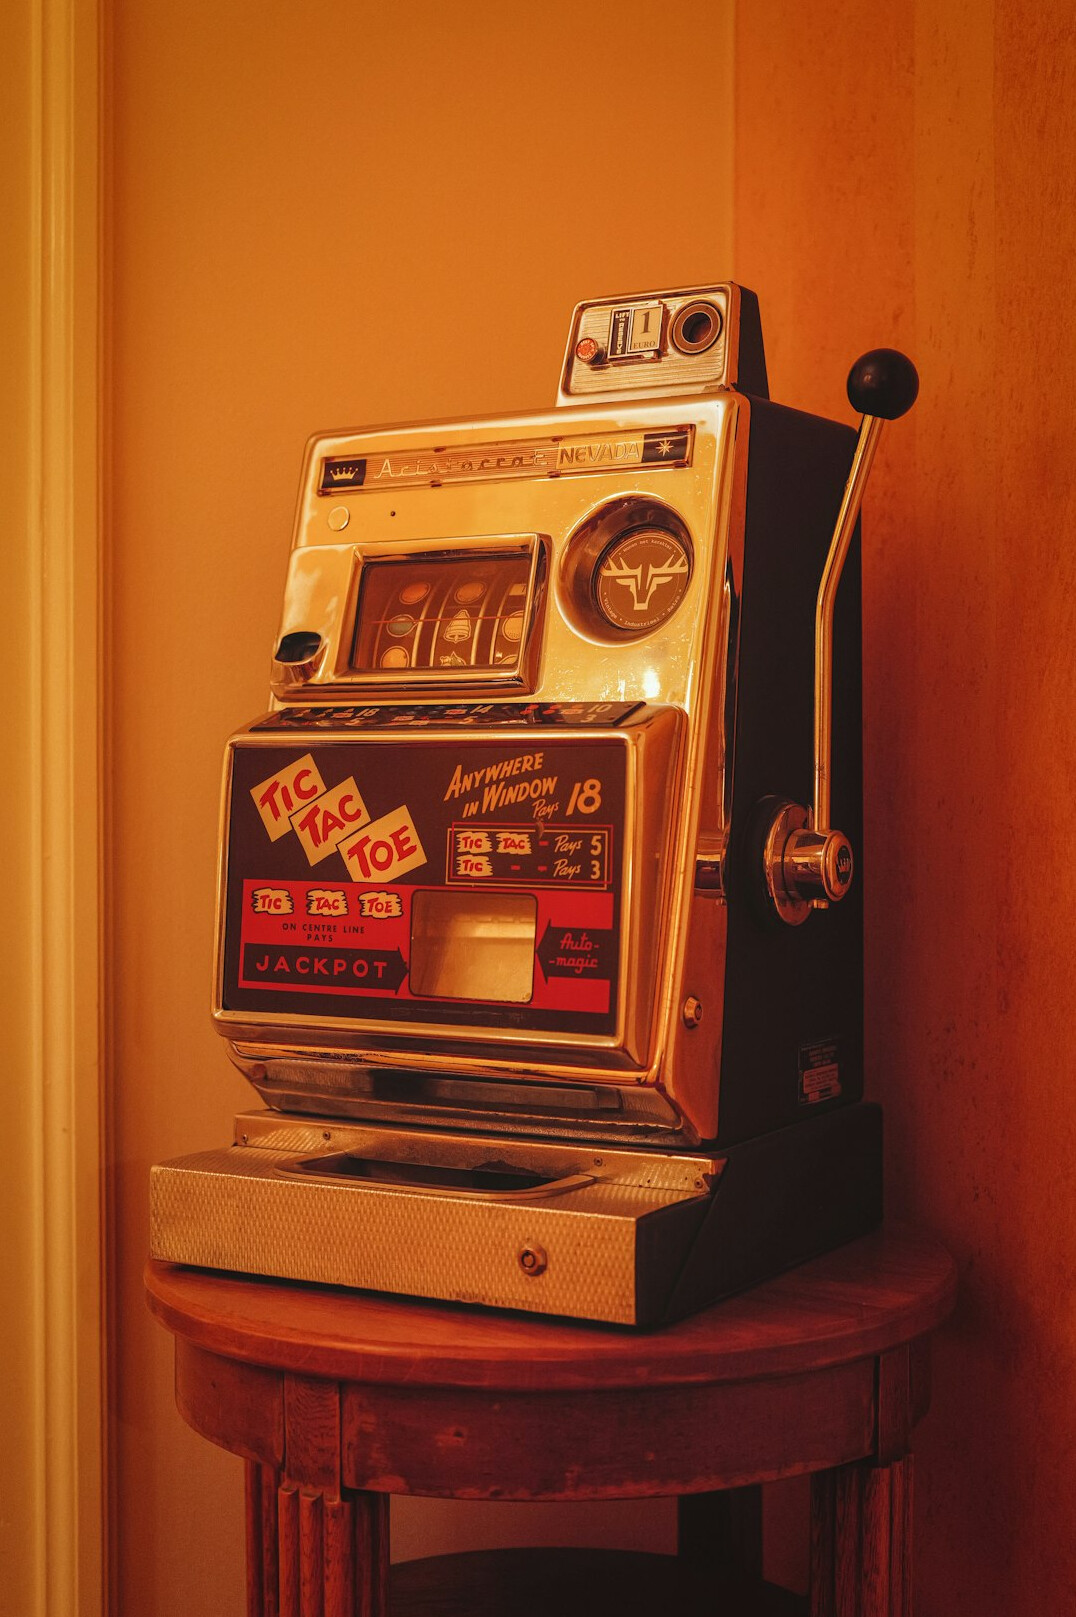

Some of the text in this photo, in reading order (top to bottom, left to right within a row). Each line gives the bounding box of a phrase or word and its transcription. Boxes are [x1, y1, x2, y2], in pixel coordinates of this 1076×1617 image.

[640, 311, 651, 334] 1
[633, 340, 656, 349] EURO
[560, 442, 640, 464] NEVADA
[580, 714, 598, 723] 3
[587, 704, 612, 713] 10
[443, 752, 544, 801] ANYWHERE
[259, 769, 318, 821] TIC
[532, 778, 602, 819] Pays 18
[462, 801, 479, 818] IN
[298, 794, 362, 848] TAC
[347, 825, 417, 879] TOE
[462, 834, 602, 856] TIC TAC Pays 5
[462, 858, 601, 879] TIC Pays 3
[260, 894, 392, 913] TIC TAC TOE
[282, 923, 365, 934] ON CENTRE LINE
[307, 934, 333, 942] PAYS
[256, 955, 387, 978] JACKPOT
